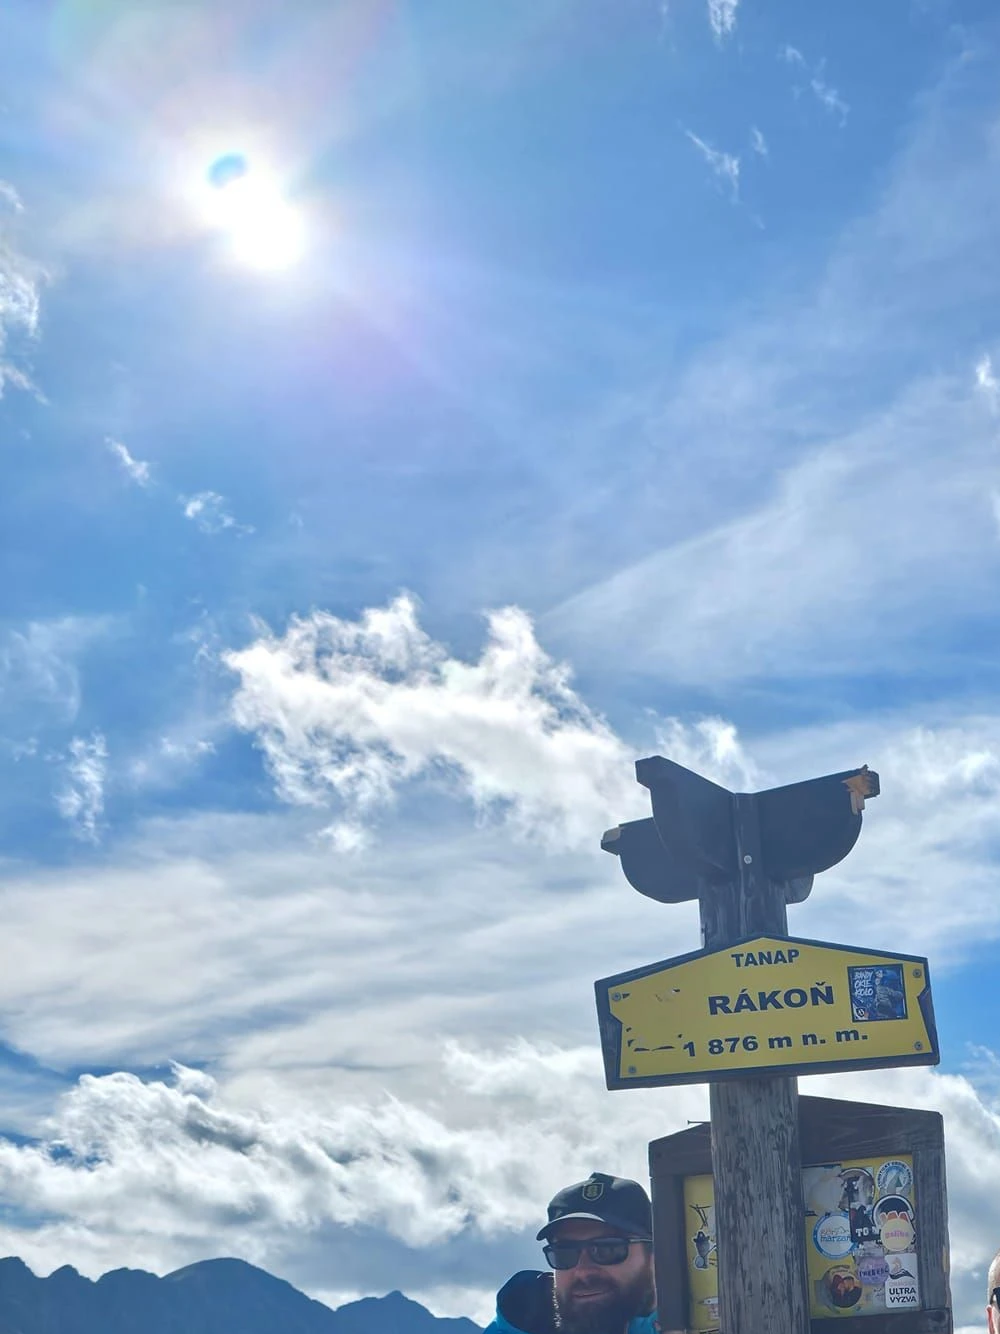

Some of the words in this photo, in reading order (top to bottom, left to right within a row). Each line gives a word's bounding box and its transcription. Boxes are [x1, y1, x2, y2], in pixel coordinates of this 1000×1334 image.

[731, 949, 800, 968] TANAP
[708, 981, 834, 1016] RÁKOŇ
[683, 1041, 696, 1057] 1
[708, 1035, 759, 1055] 876
[768, 1036, 793, 1049] m
[802, 1033, 826, 1046] n.
[835, 1029, 868, 1042] m.
[889, 1287, 917, 1296] ULTRA
